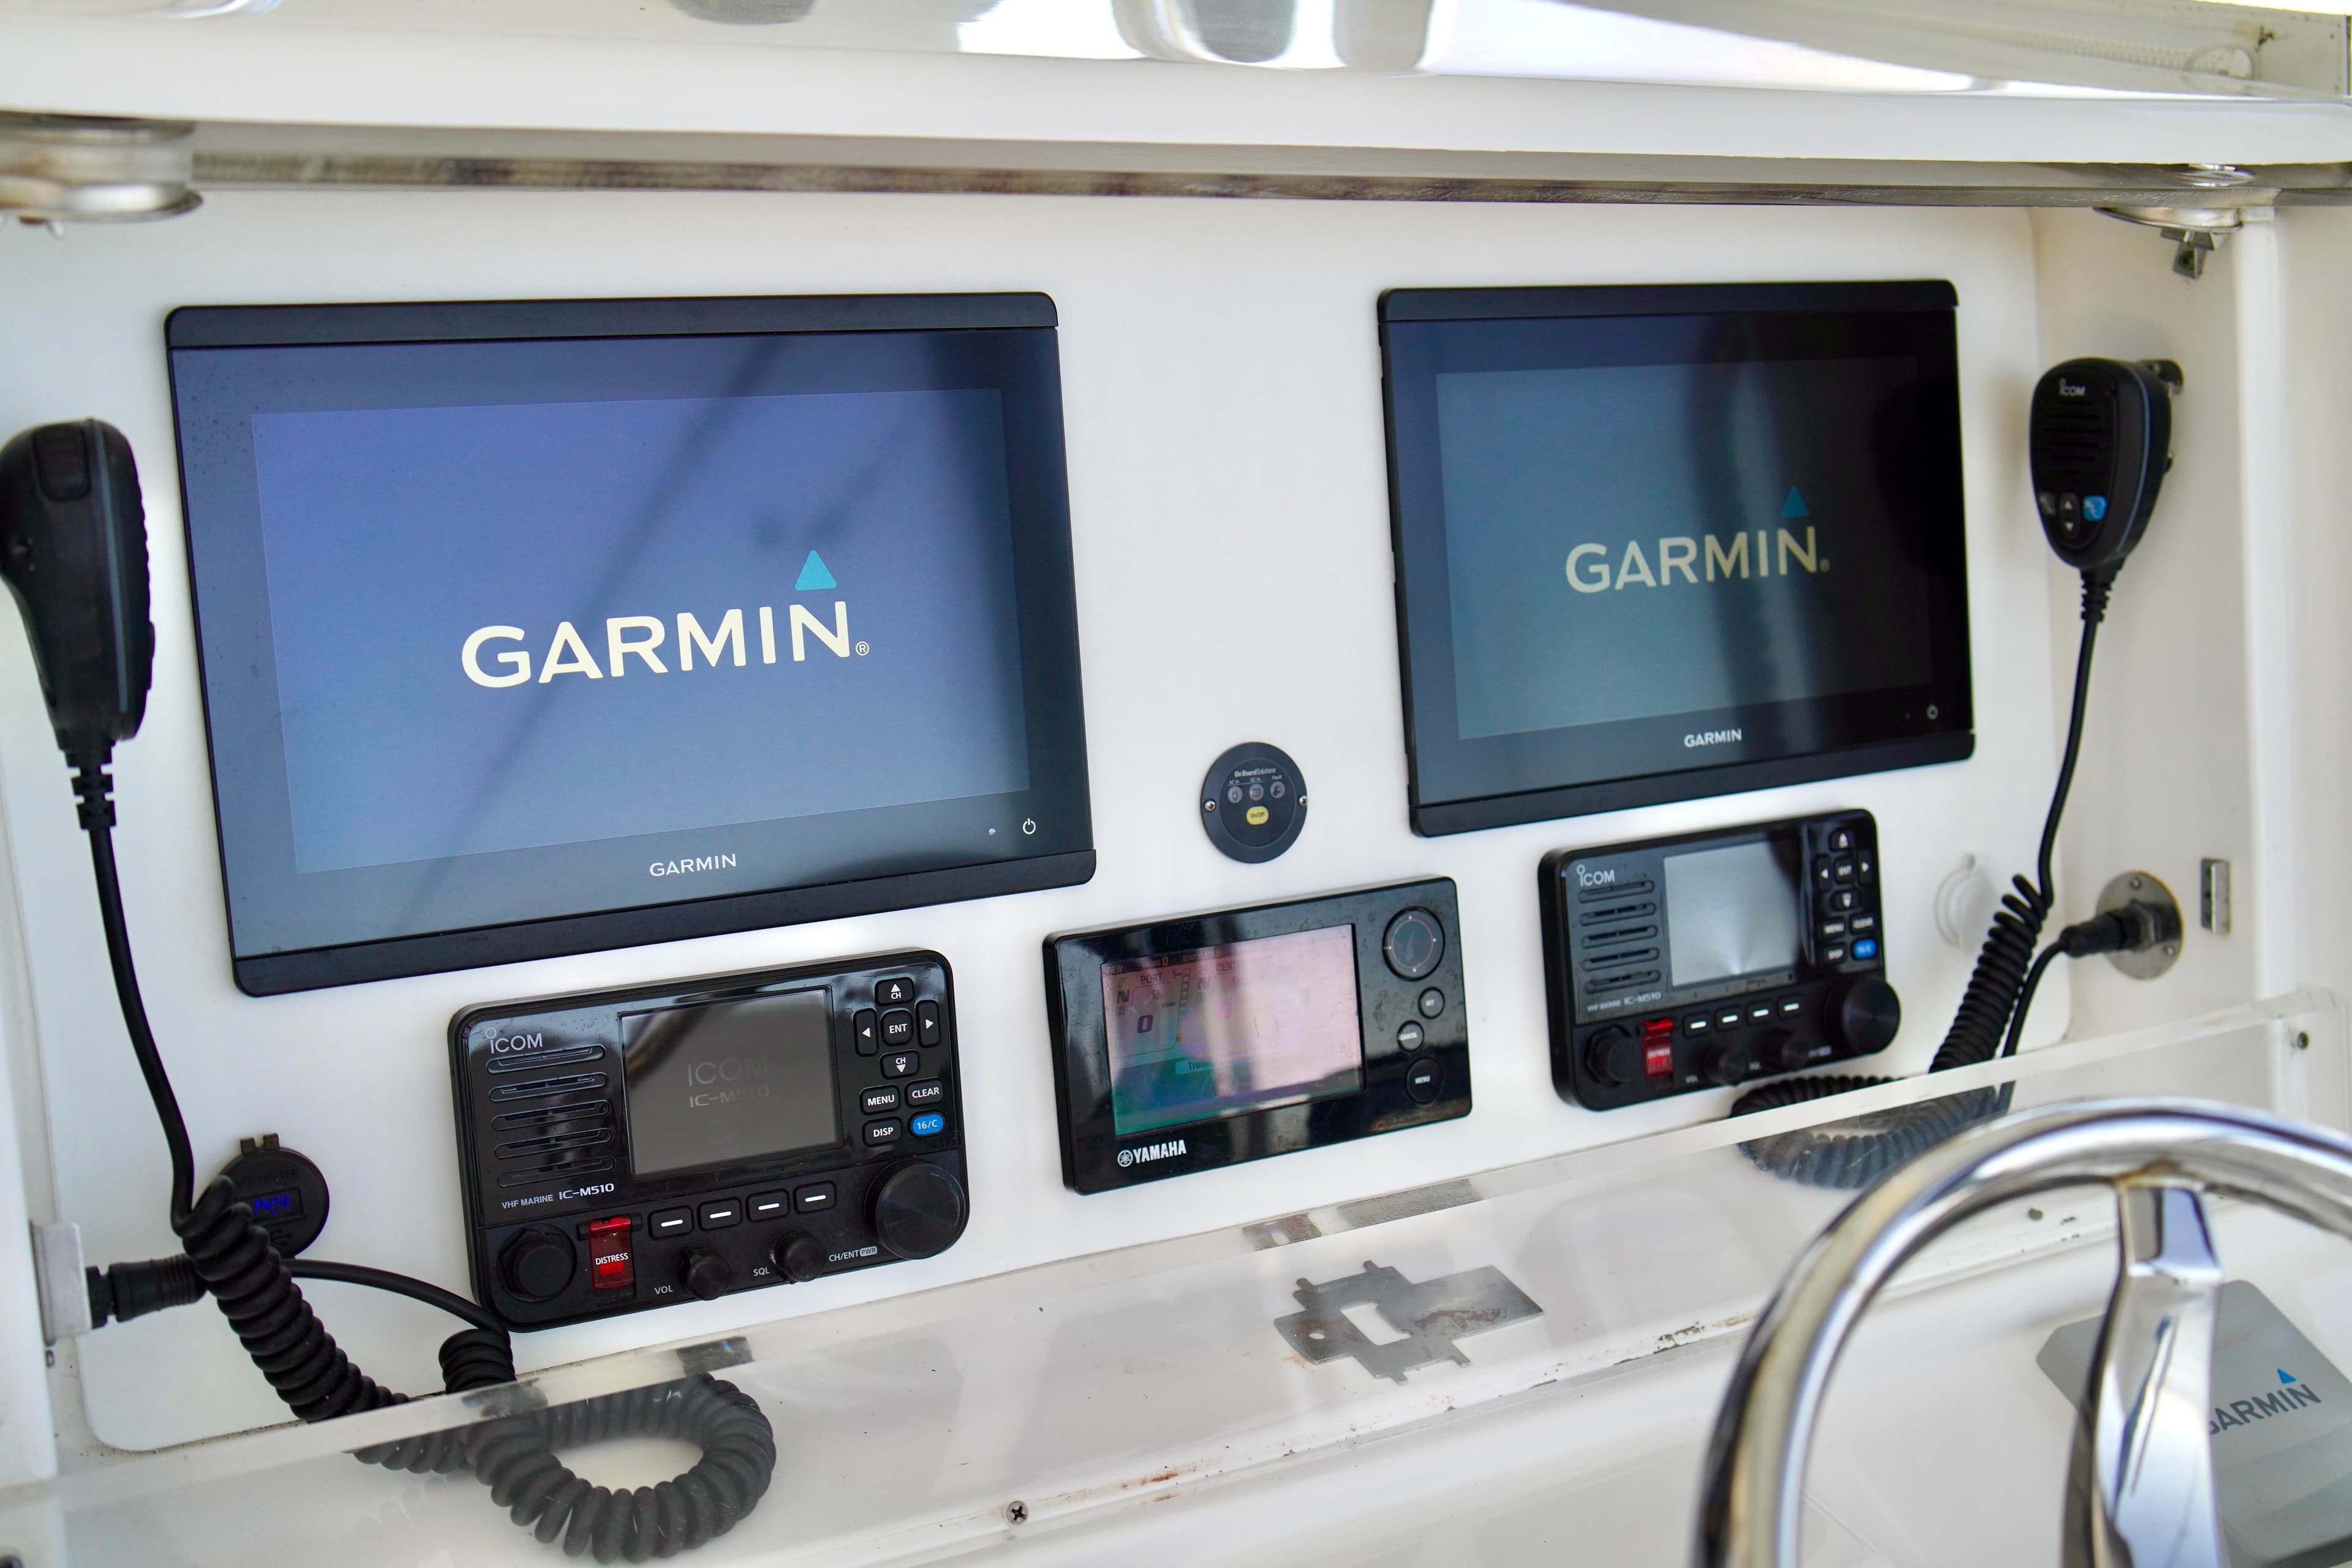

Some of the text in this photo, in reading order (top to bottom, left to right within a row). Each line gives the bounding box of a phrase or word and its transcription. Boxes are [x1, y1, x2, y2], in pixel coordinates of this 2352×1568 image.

[1684, 728, 1742, 748] GARMIN
[649, 853, 737, 877] GARMIN
[1140, 973, 1163, 984] PORT
[889, 1023, 908, 1034] ENT
[687, 1054, 770, 1087] ICOM
[911, 1087, 940, 1099] CLEAR
[867, 1094, 895, 1106] MENU
[916, 1118, 938, 1130] 16/C
[873, 1126, 894, 1137] DISP
[1133, 1139, 1186, 1164] YAMAHA
[502, 1183, 615, 1209] VHF MARINE IC-M510
[595, 1253, 629, 1265] DISTRESS
[829, 1246, 877, 1262] CH/ENT PWR
[753, 1267, 770, 1276] SQL
[654, 1285, 673, 1295] VOL
